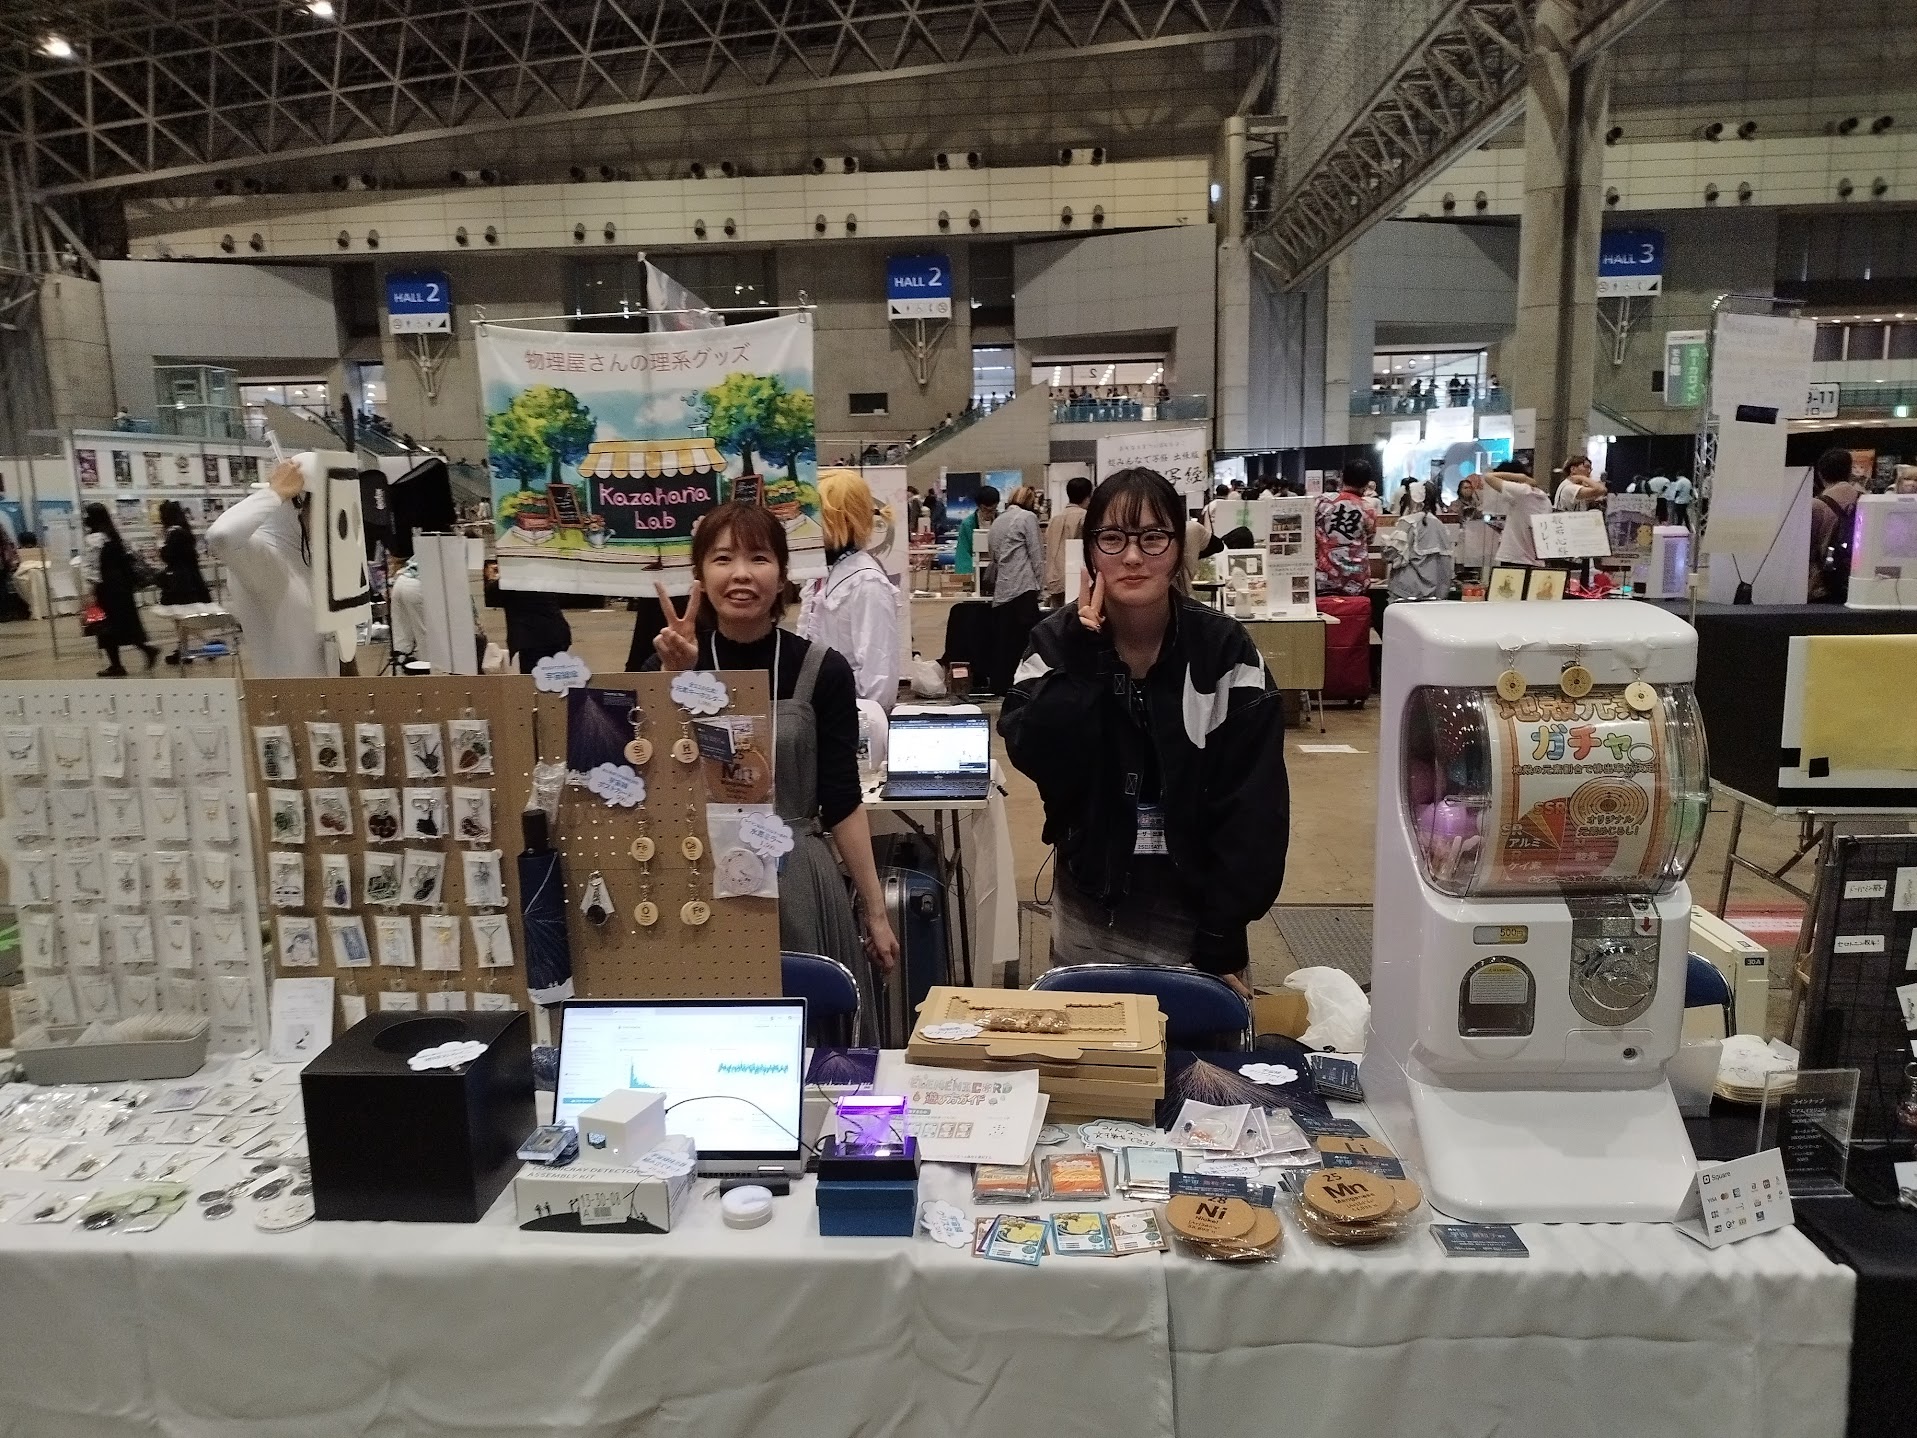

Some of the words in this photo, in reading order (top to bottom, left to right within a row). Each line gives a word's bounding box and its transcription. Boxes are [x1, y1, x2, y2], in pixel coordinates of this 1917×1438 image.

[1603, 254, 1637, 264] HALL
[1640, 243, 1655, 264] 3
[893, 277, 925, 287] HALL
[928, 266, 942, 286] 2
[394, 293, 424, 302] HALL
[426, 283, 441, 302] 2
[525, 343, 751, 373] 物理屋さんの理系グッズ
[599, 482, 711, 507] Kazahana
[635, 511, 677, 530] Lab
[1328, 503, 1363, 541] 超
[1531, 723, 1633, 761] ガチャ
[1533, 801, 1566, 815] SSR
[1508, 838, 1541, 848] アルミ
[923, 1091, 986, 1106] 遊び方ガイド
[1344, 1142, 1369, 1154] Li
[527, 1172, 578, 1180] ASSEMBLY
[1322, 1172, 1343, 1182] 25
[1711, 1171, 1731, 1181] Square
[1322, 1183, 1369, 1199] Mn
[1195, 1215, 1219, 1224] Nickel
[1196, 1203, 1228, 1220] Ni
